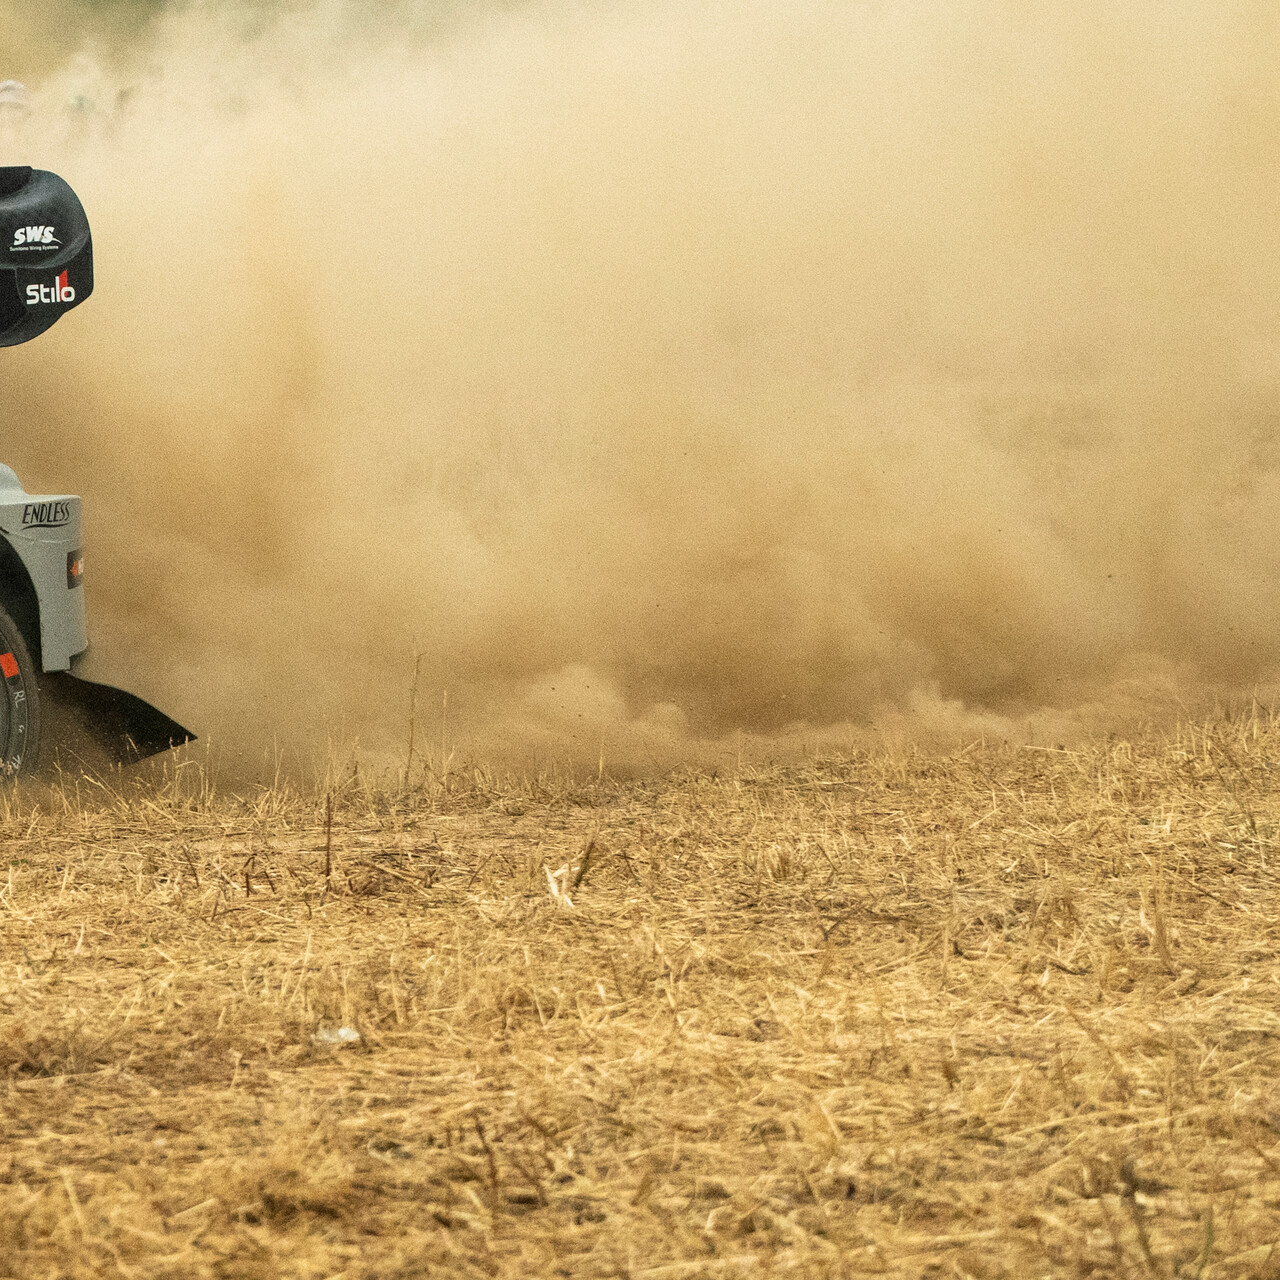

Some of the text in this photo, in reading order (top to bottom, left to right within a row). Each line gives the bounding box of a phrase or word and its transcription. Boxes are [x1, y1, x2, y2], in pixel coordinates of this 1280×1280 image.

[13, 225, 56, 246] SWS
[25, 273, 76, 305] Stilo
[22, 502, 70, 524] ENDLESS
